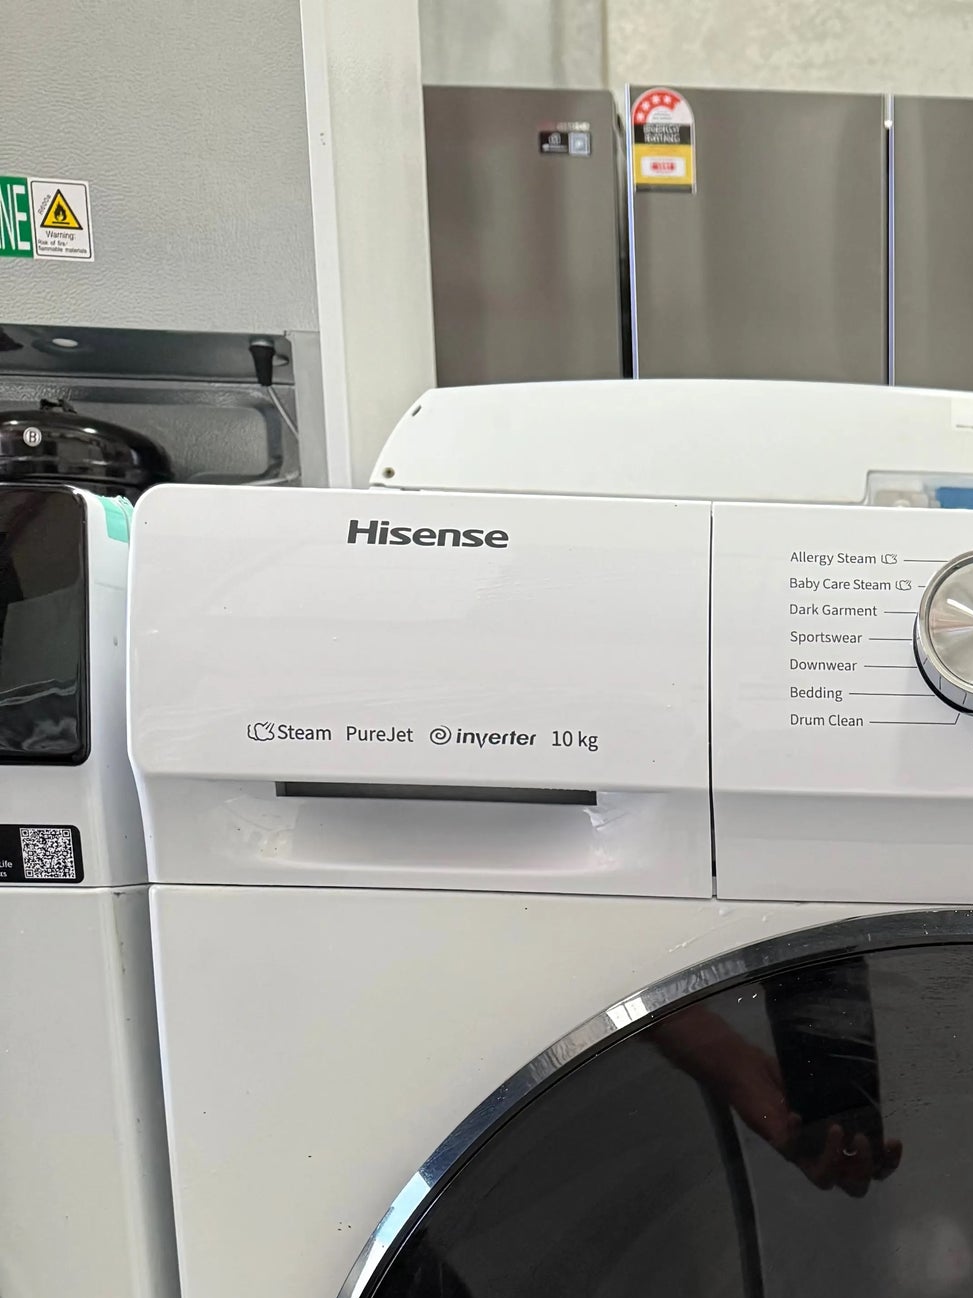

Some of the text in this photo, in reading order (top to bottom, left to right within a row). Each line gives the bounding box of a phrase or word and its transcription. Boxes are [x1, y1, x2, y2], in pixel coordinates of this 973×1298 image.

[0, 184, 31, 250] NE
[347, 520, 509, 549] Hisense
[790, 551, 877, 566] Allergy Steam
[789, 577, 891, 592] Baby Care Steam
[789, 603, 878, 617] Dark Garment
[790, 631, 863, 646] Sportswear
[789, 659, 858, 671] Downwear
[790, 687, 842, 702] Bedding
[790, 714, 864, 727] Drum Clean
[277, 724, 599, 752] Steam PureJet inverter 10 kg
